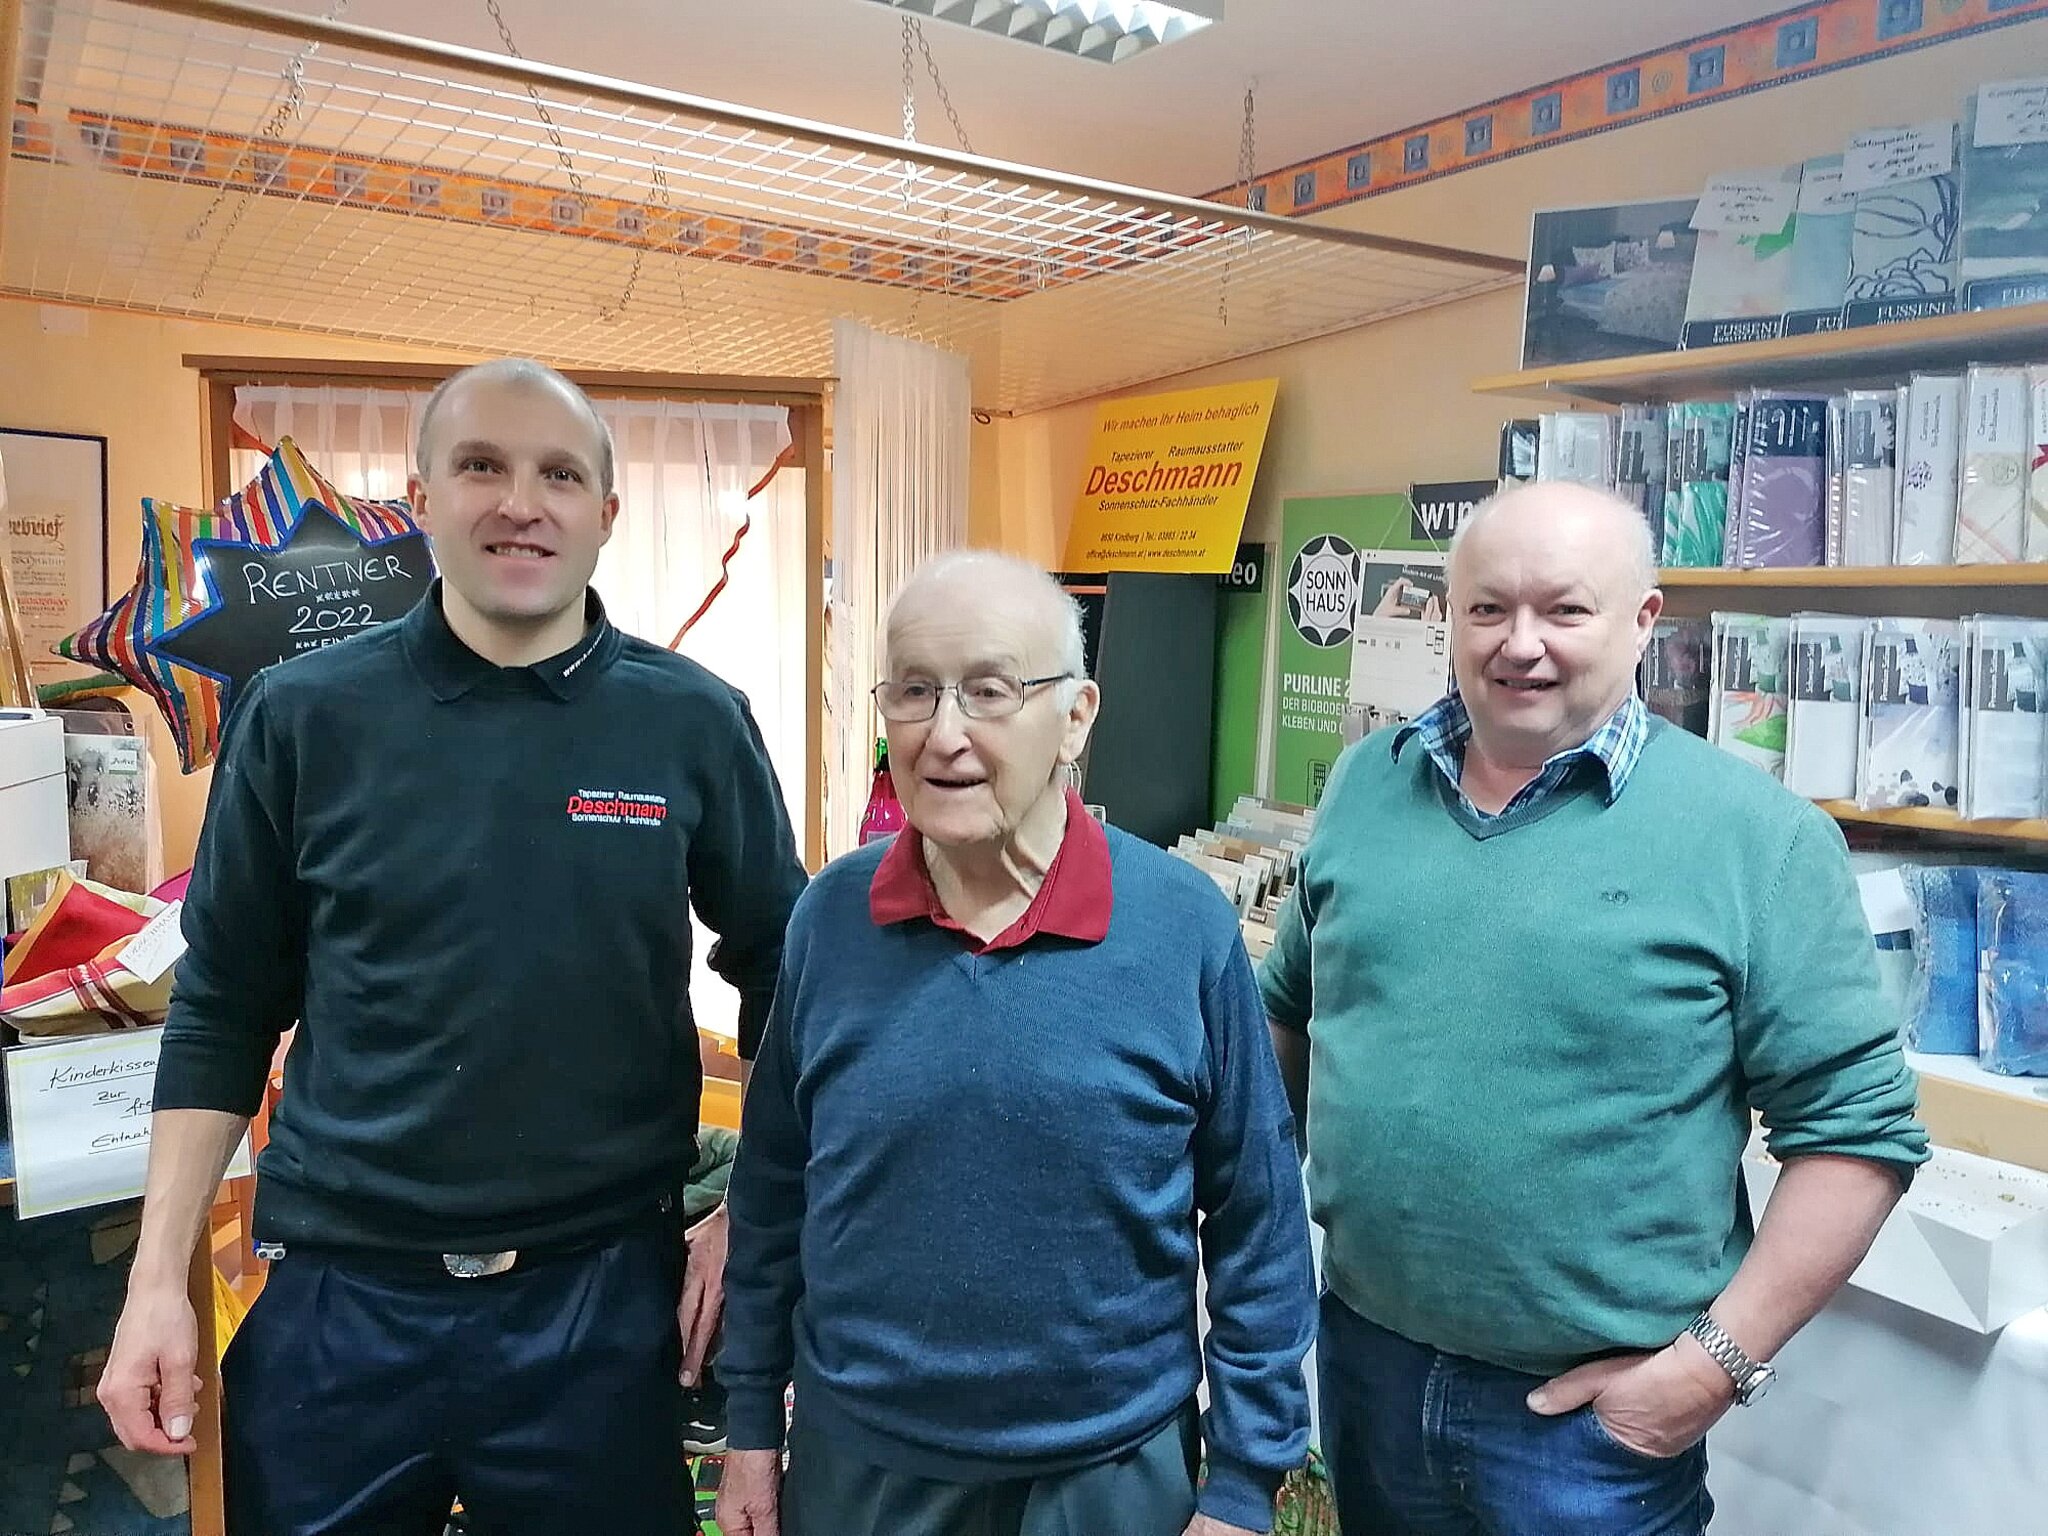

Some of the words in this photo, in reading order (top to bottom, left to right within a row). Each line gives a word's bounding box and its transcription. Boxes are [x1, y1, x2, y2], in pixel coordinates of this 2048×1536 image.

[1103, 419, 1118, 432] Wir
[1119, 415, 1158, 431] machen
[1176, 409, 1203, 424] Heim
[1204, 401, 1260, 421] behaglich
[1111, 450, 1154, 464] Tapezierer
[1168, 441, 1244, 458] Raumausstatter
[1085, 460, 1243, 496] Deschmann
[1099, 494, 1219, 511] Sonnenschutz-Fachhändler
[242, 555, 413, 604] RENTNER
[1306, 570, 1346, 590] SONN
[1306, 592, 1345, 612] HAUS
[288, 604, 383, 634] 2022
[1283, 673, 1341, 697] PURLINE
[1282, 696, 1300, 711] DER
[1282, 713, 1315, 731] KLEBEN
[1317, 717, 1337, 734] UND
[567, 795, 667, 819] Deschmann
[50, 1059, 157, 1089] Kinderkissen
